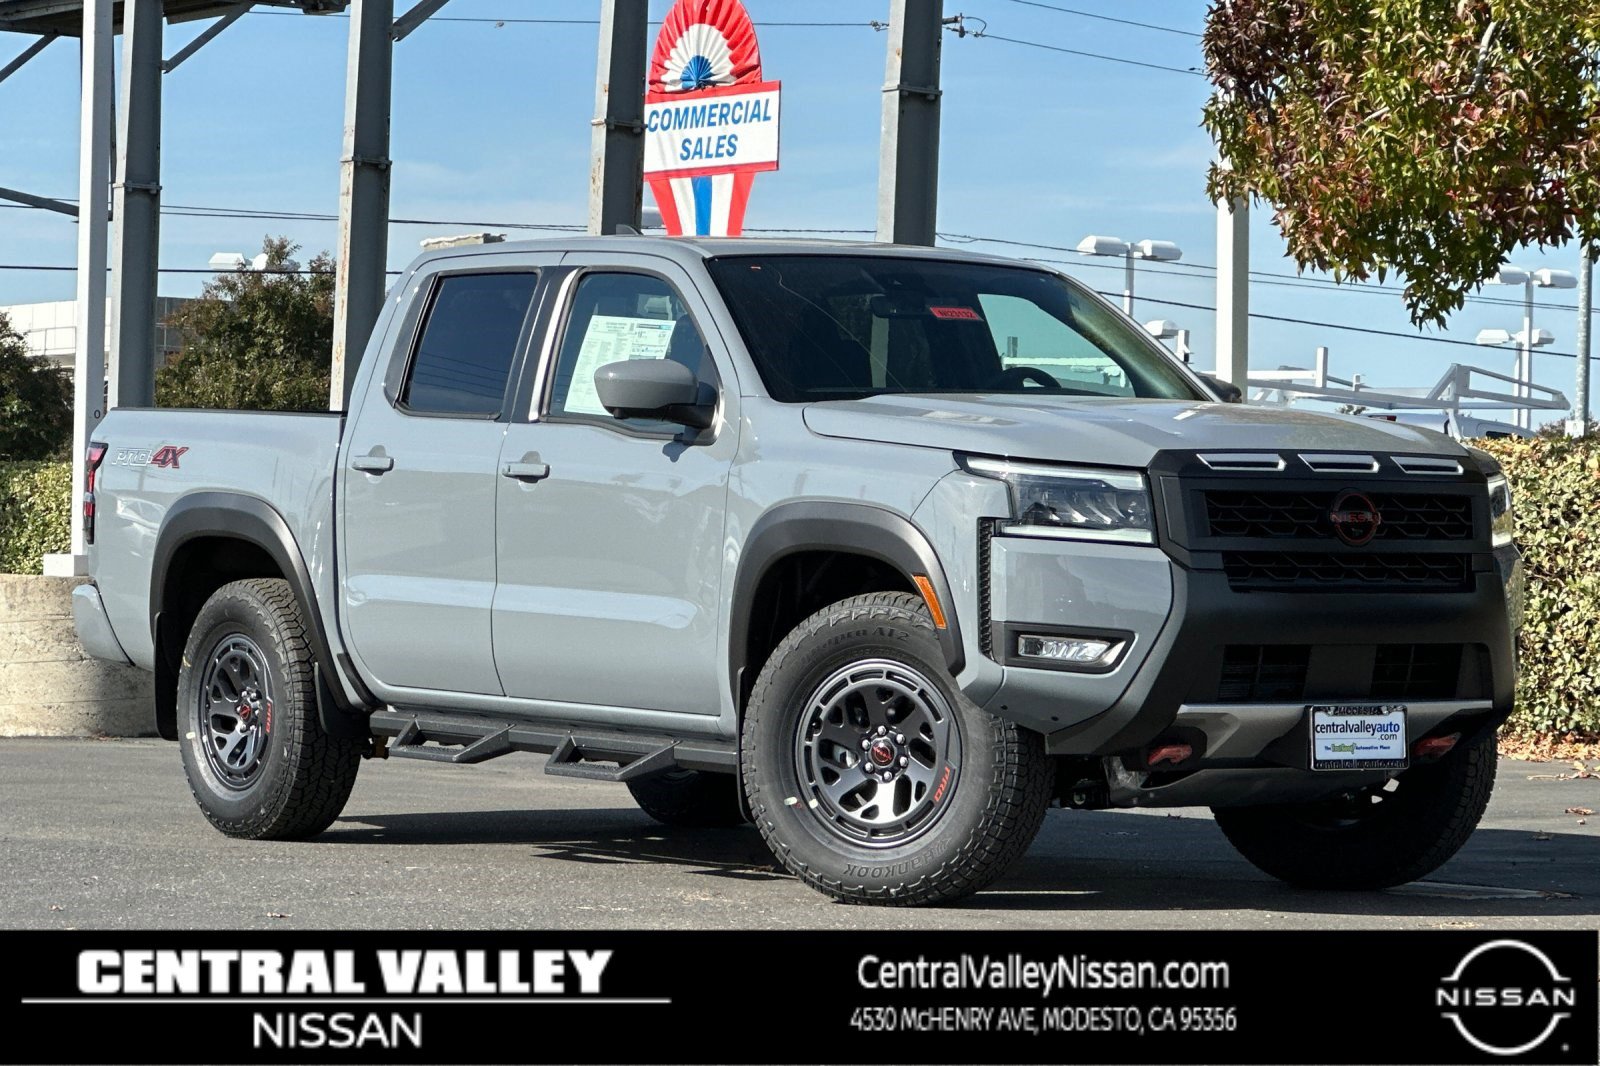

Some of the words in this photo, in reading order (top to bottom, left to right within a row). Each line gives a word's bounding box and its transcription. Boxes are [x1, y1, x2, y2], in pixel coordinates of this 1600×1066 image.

[648, 98, 772, 132] COMMERCIAL
[680, 134, 739, 161] SALES
[1315, 720, 1400, 736] centralvalleyauto
